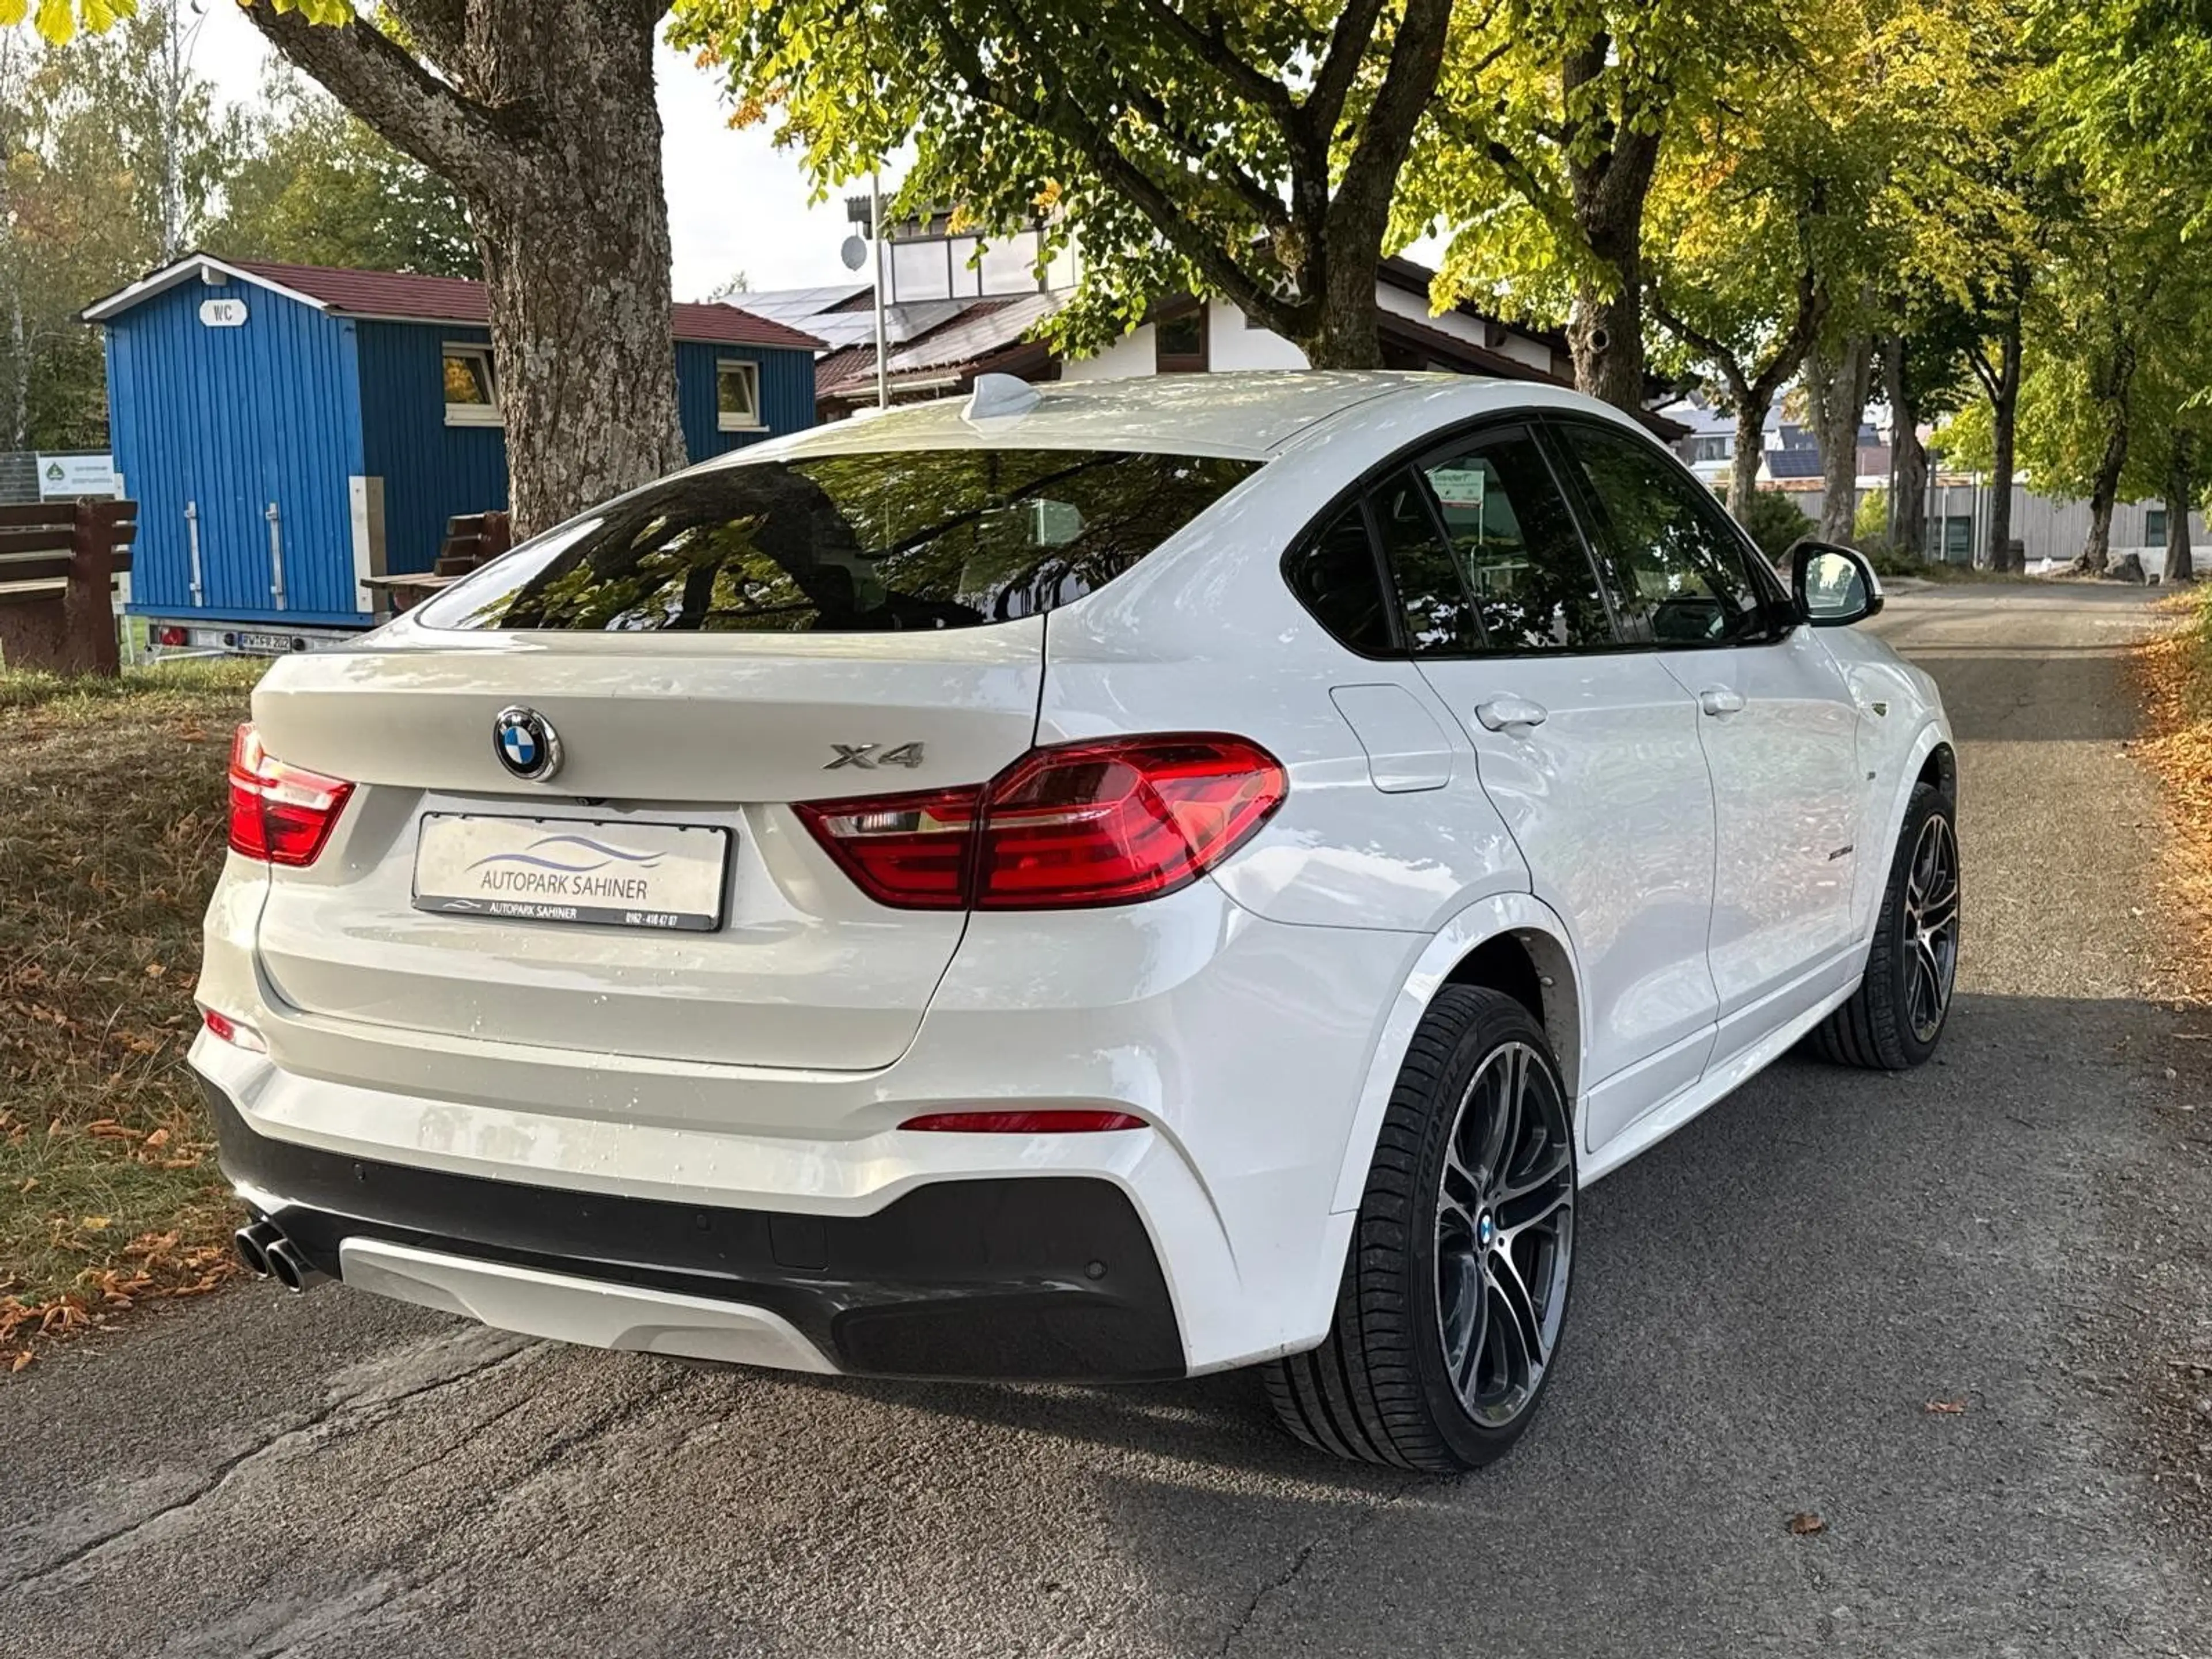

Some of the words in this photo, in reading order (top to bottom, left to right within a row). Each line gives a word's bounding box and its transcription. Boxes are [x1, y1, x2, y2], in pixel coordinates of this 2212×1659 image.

[213, 304, 233, 321] WC
[819, 741, 925, 770] X4
[481, 870, 569, 893] AUTOPARK
[571, 876, 648, 899] SAHINER
[490, 902, 534, 915] AUTOPARK
[536, 906, 577, 919] SAHINER
